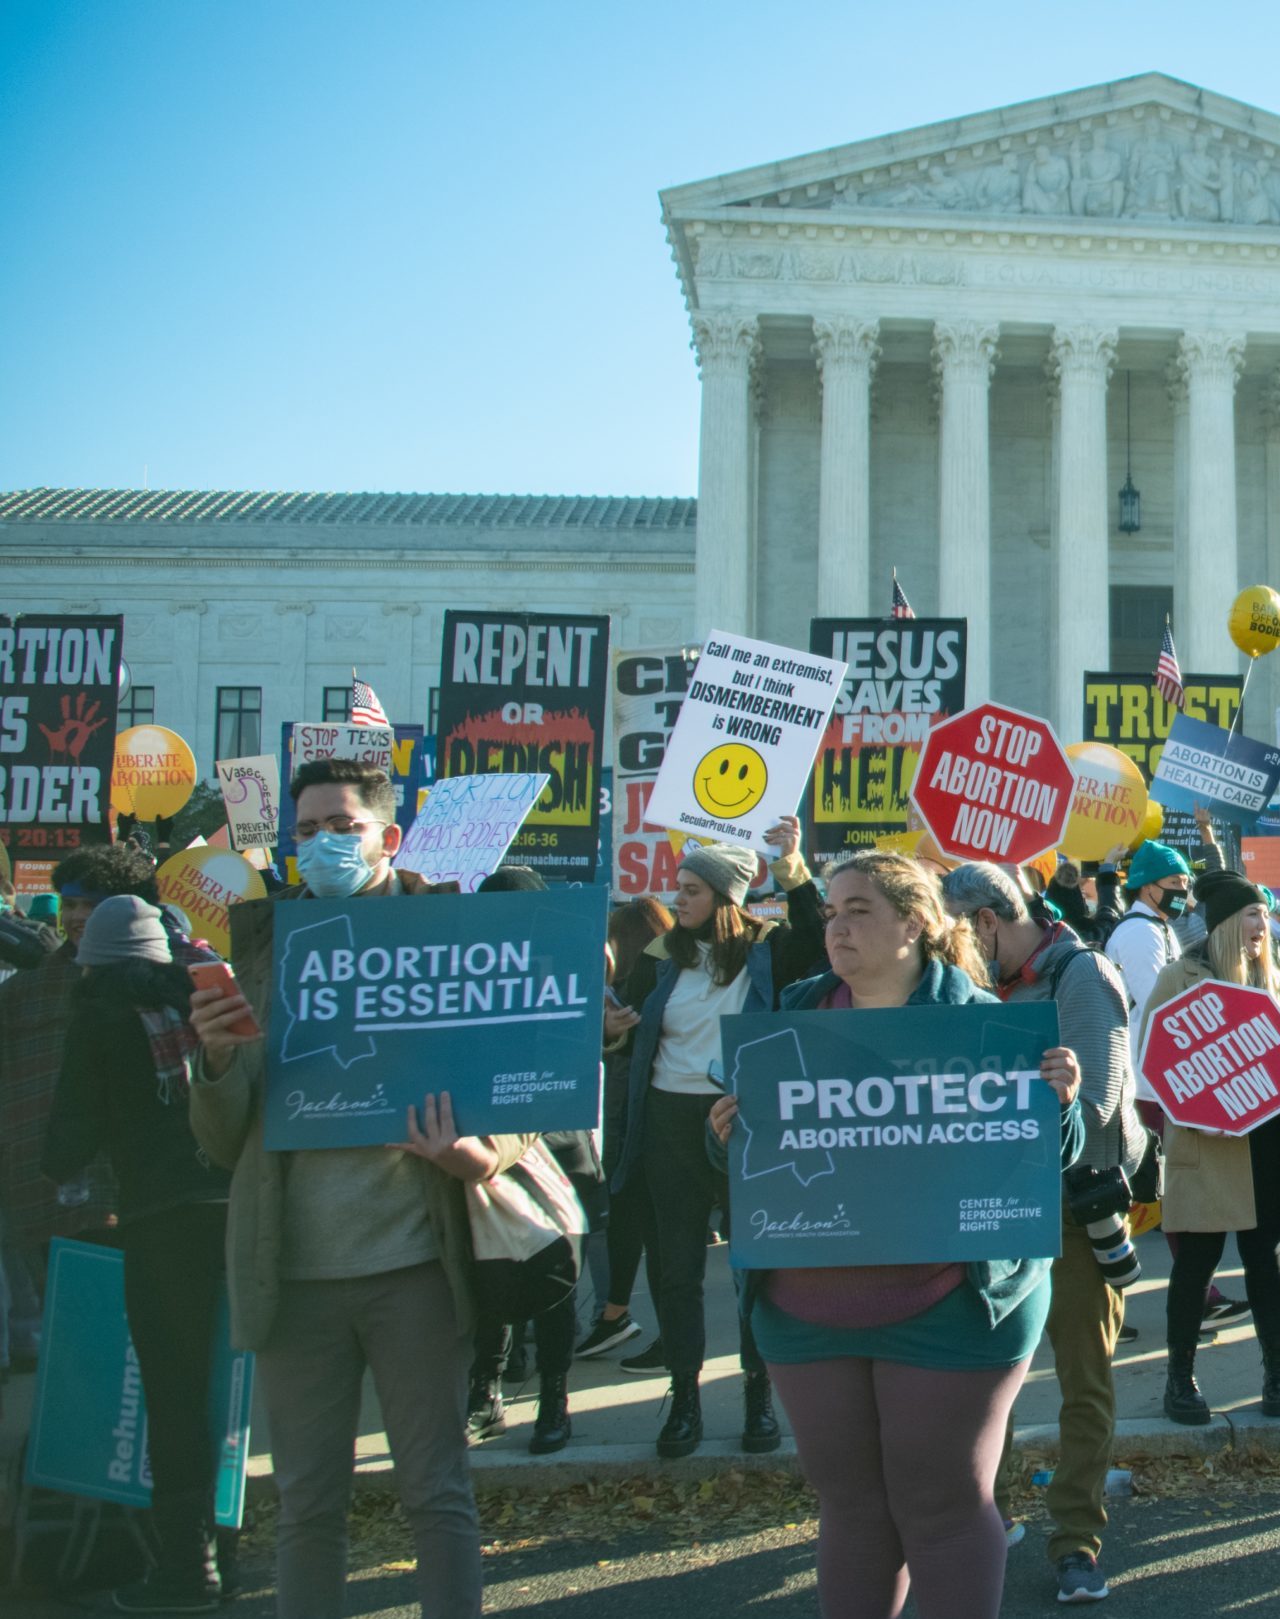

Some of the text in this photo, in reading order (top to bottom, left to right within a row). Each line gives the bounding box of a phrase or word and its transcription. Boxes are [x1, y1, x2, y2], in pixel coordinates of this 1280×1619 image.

[984, 263, 1064, 285] EQUAL
[1069, 265, 1168, 289] JUSTICE
[1180, 271, 1257, 292] UNDER
[453, 622, 598, 687] REPENT
[706, 641, 834, 686] Call me an extremist,
[731, 670, 796, 698] but I think
[834, 680, 942, 714] SAVES
[502, 702, 544, 725] OR
[689, 681, 825, 730] DISMEMBERMENT
[1086, 684, 1240, 739] TRUST
[301, 726, 389, 747] STOP TEXAS
[711, 714, 783, 746] is WRONG
[842, 713, 930, 744] FROM
[975, 714, 1042, 768] STOP
[1170, 745, 1247, 781] ABORTION
[1248, 772, 1264, 788] IS
[0, 765, 101, 823] DER
[929, 751, 1059, 825] ABORTION
[1163, 764, 1262, 808] HEALTH CARE
[17, 828, 80, 848] 20:13
[236, 821, 276, 832] PREVENT
[236, 831, 279, 845] ABORTION
[455, 821, 518, 849] BODIES
[679, 812, 753, 841] SecularProLife.org
[951, 803, 1018, 857] NOW
[299, 940, 531, 983] ABORTION
[299, 973, 588, 1021] IS ESSENTIAL
[1162, 992, 1227, 1050] STOP
[492, 1080, 577, 1094] REPRODUCTIVE
[493, 1073, 537, 1084] CENTER
[1212, 1062, 1279, 1121] NOW
[491, 1094, 534, 1105] RIGHTS
[778, 1070, 1042, 1121] PROTECT
[779, 1120, 1040, 1151] ABORTION ACCESS
[959, 1198, 1003, 1210] CENTER
[959, 1207, 1042, 1221] REPRODUCTIVE
[959, 1221, 1000, 1233] RIGHTS
